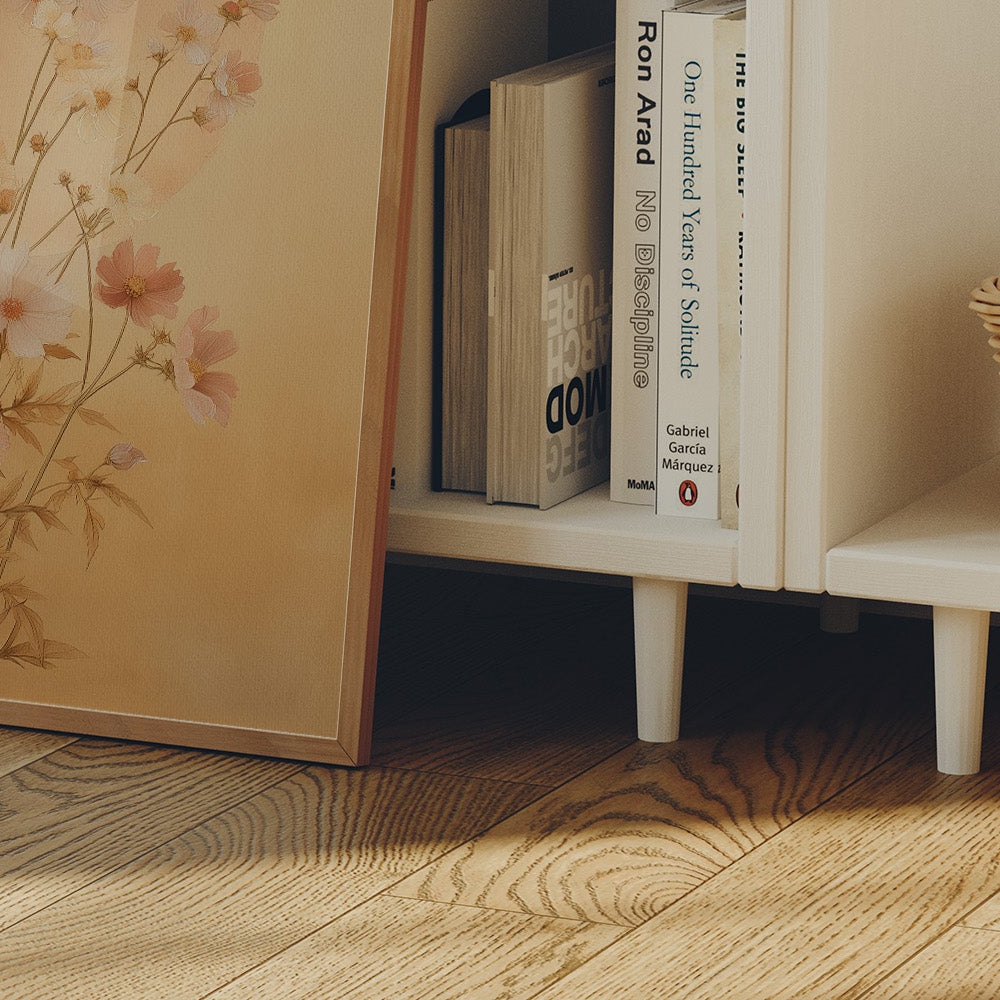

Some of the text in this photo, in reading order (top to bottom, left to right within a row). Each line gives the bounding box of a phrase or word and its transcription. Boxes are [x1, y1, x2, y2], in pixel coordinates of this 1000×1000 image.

[630, 20, 657, 389] Ron Arad No Discipline
[680, 61, 702, 379] One Hundred Years of Solitude
[546, 364, 607, 434] MOD
[666, 424, 710, 438] Gabriel
[668, 441, 706, 455] García
[662, 458, 714, 474] Márquez
[627, 478, 655, 491] MoMA
